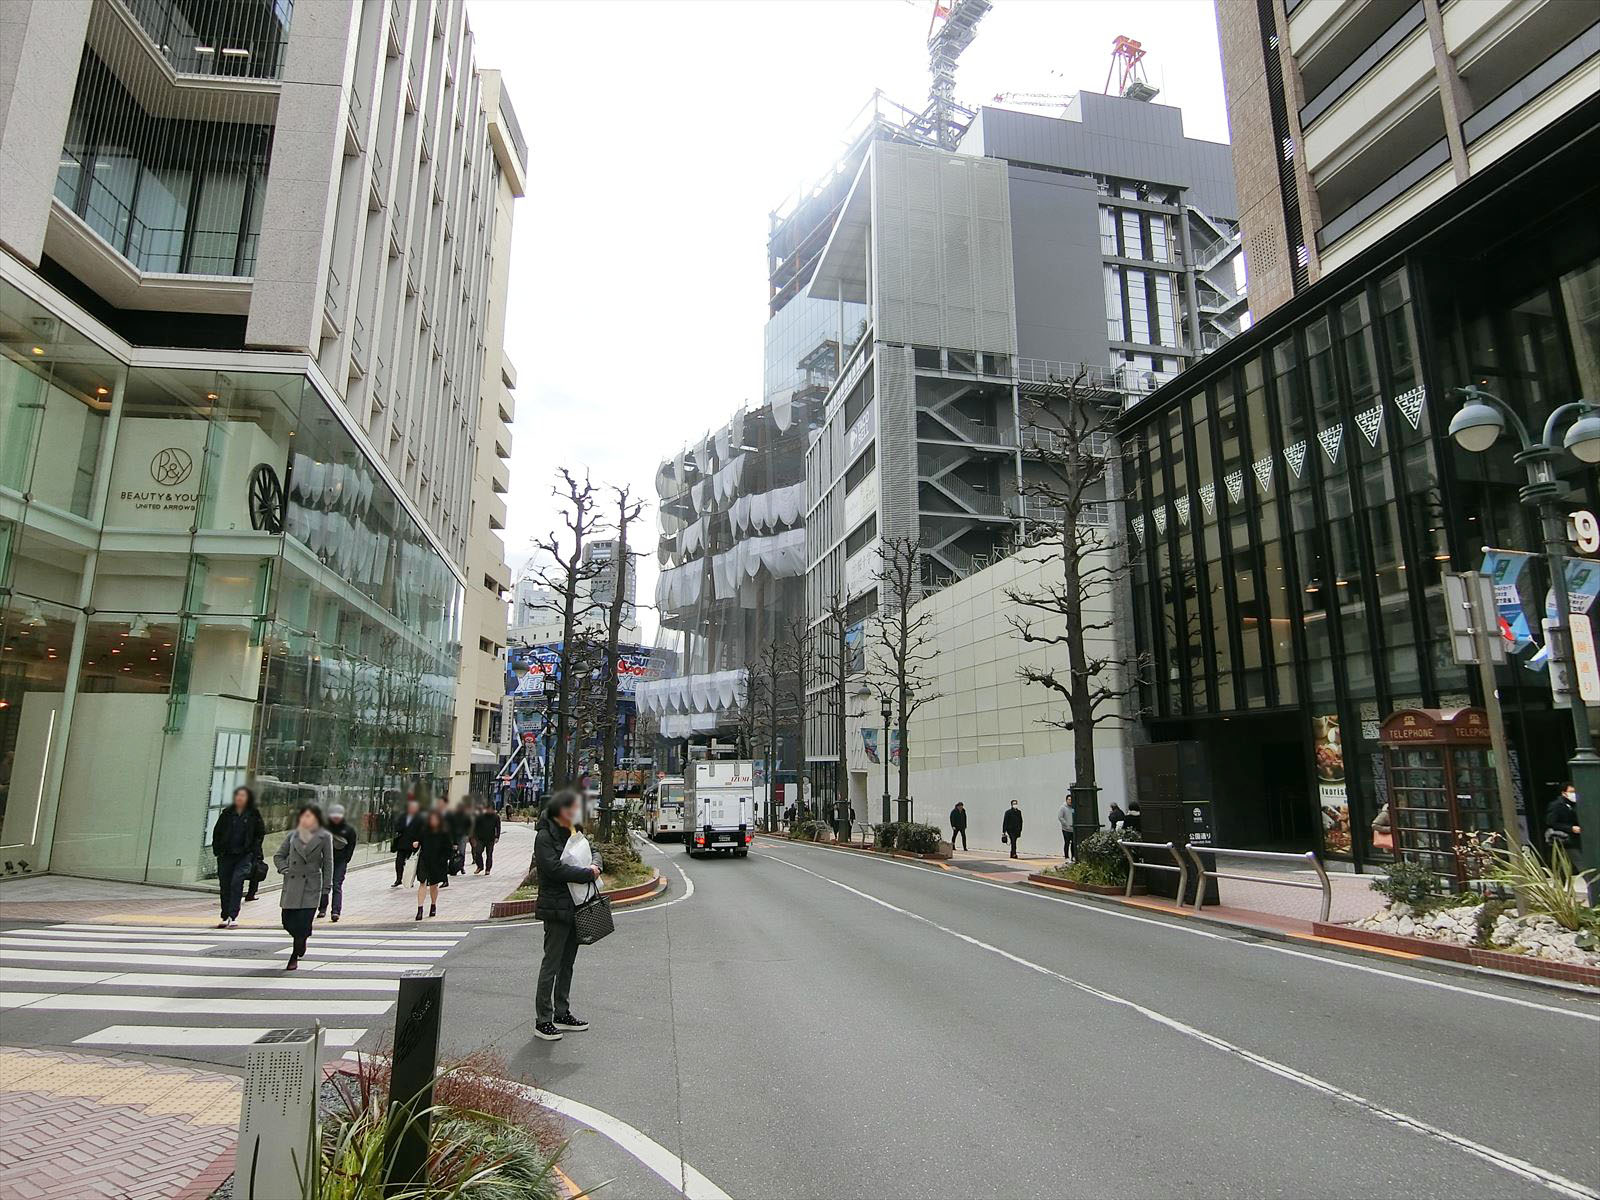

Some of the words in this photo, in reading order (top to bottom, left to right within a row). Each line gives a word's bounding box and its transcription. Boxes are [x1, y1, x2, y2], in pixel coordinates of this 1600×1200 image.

[1389, 729, 1434, 738] TELEPHONE
[1455, 727, 1490, 737] TELEPHO
[593, 763, 599, 771] 8
